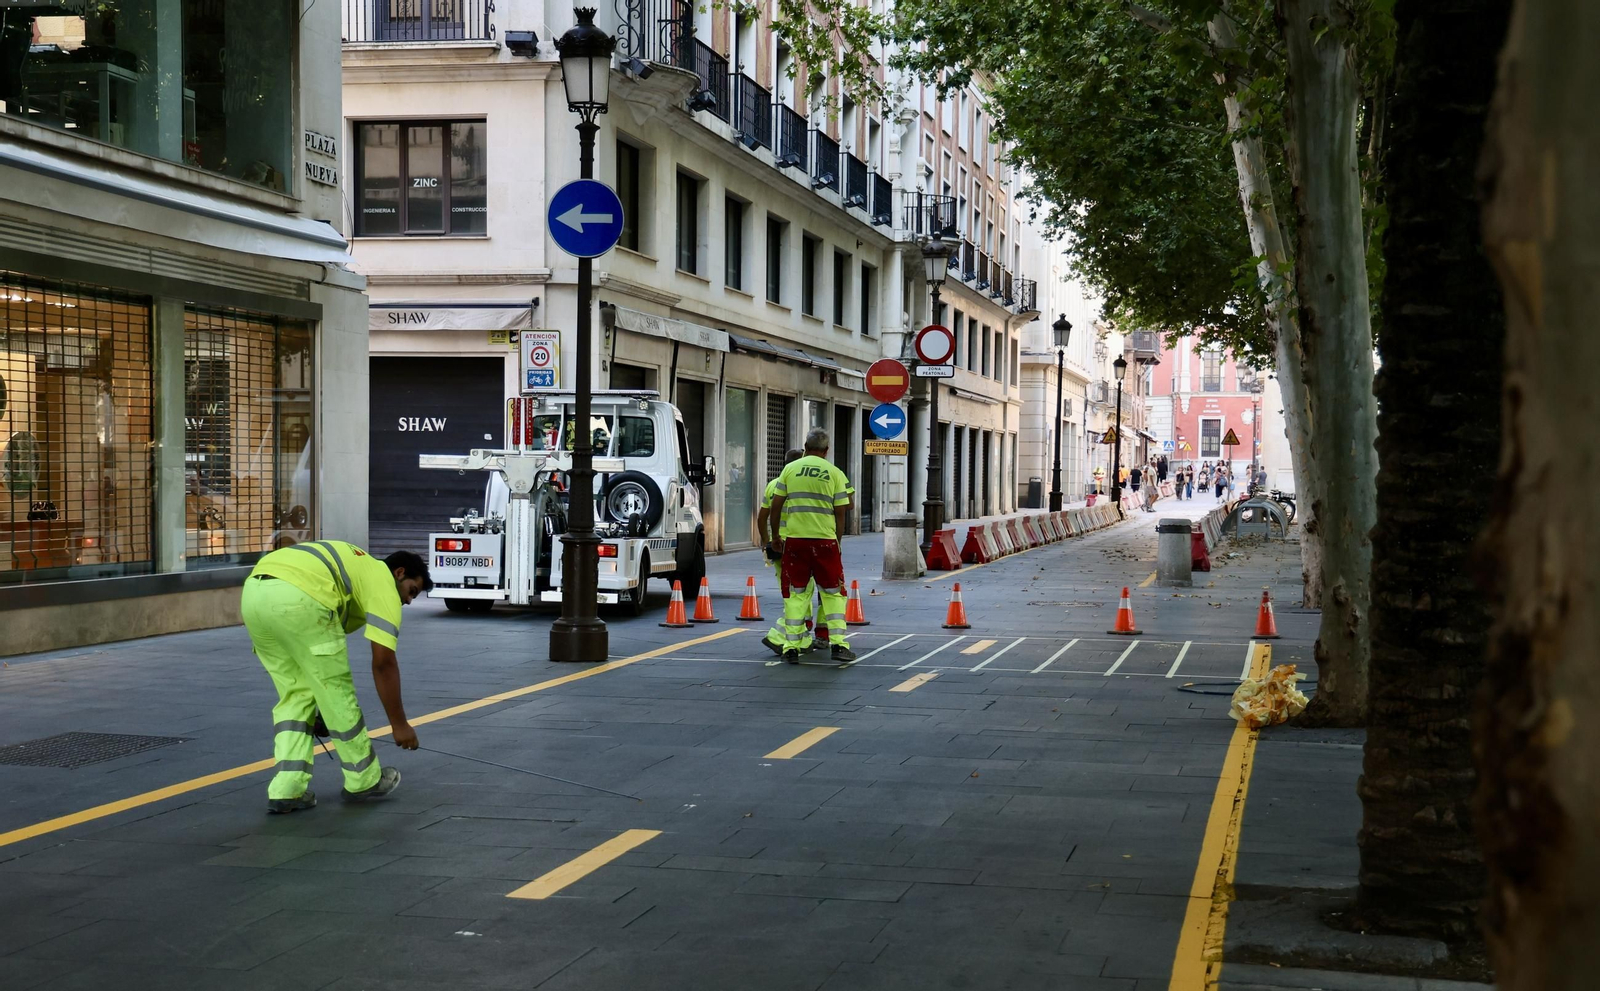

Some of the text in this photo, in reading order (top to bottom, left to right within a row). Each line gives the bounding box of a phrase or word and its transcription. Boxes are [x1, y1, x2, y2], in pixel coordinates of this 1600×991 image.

[305, 133, 336, 155] PLAZA
[305, 162, 338, 184] NUEVA
[413, 178, 438, 187] ZINC
[388, 311, 431, 325] SHAW
[535, 352, 546, 360] 20
[398, 417, 447, 432] SHAW
[795, 466, 831, 481] JICA
[445, 557, 469, 567] 9087
